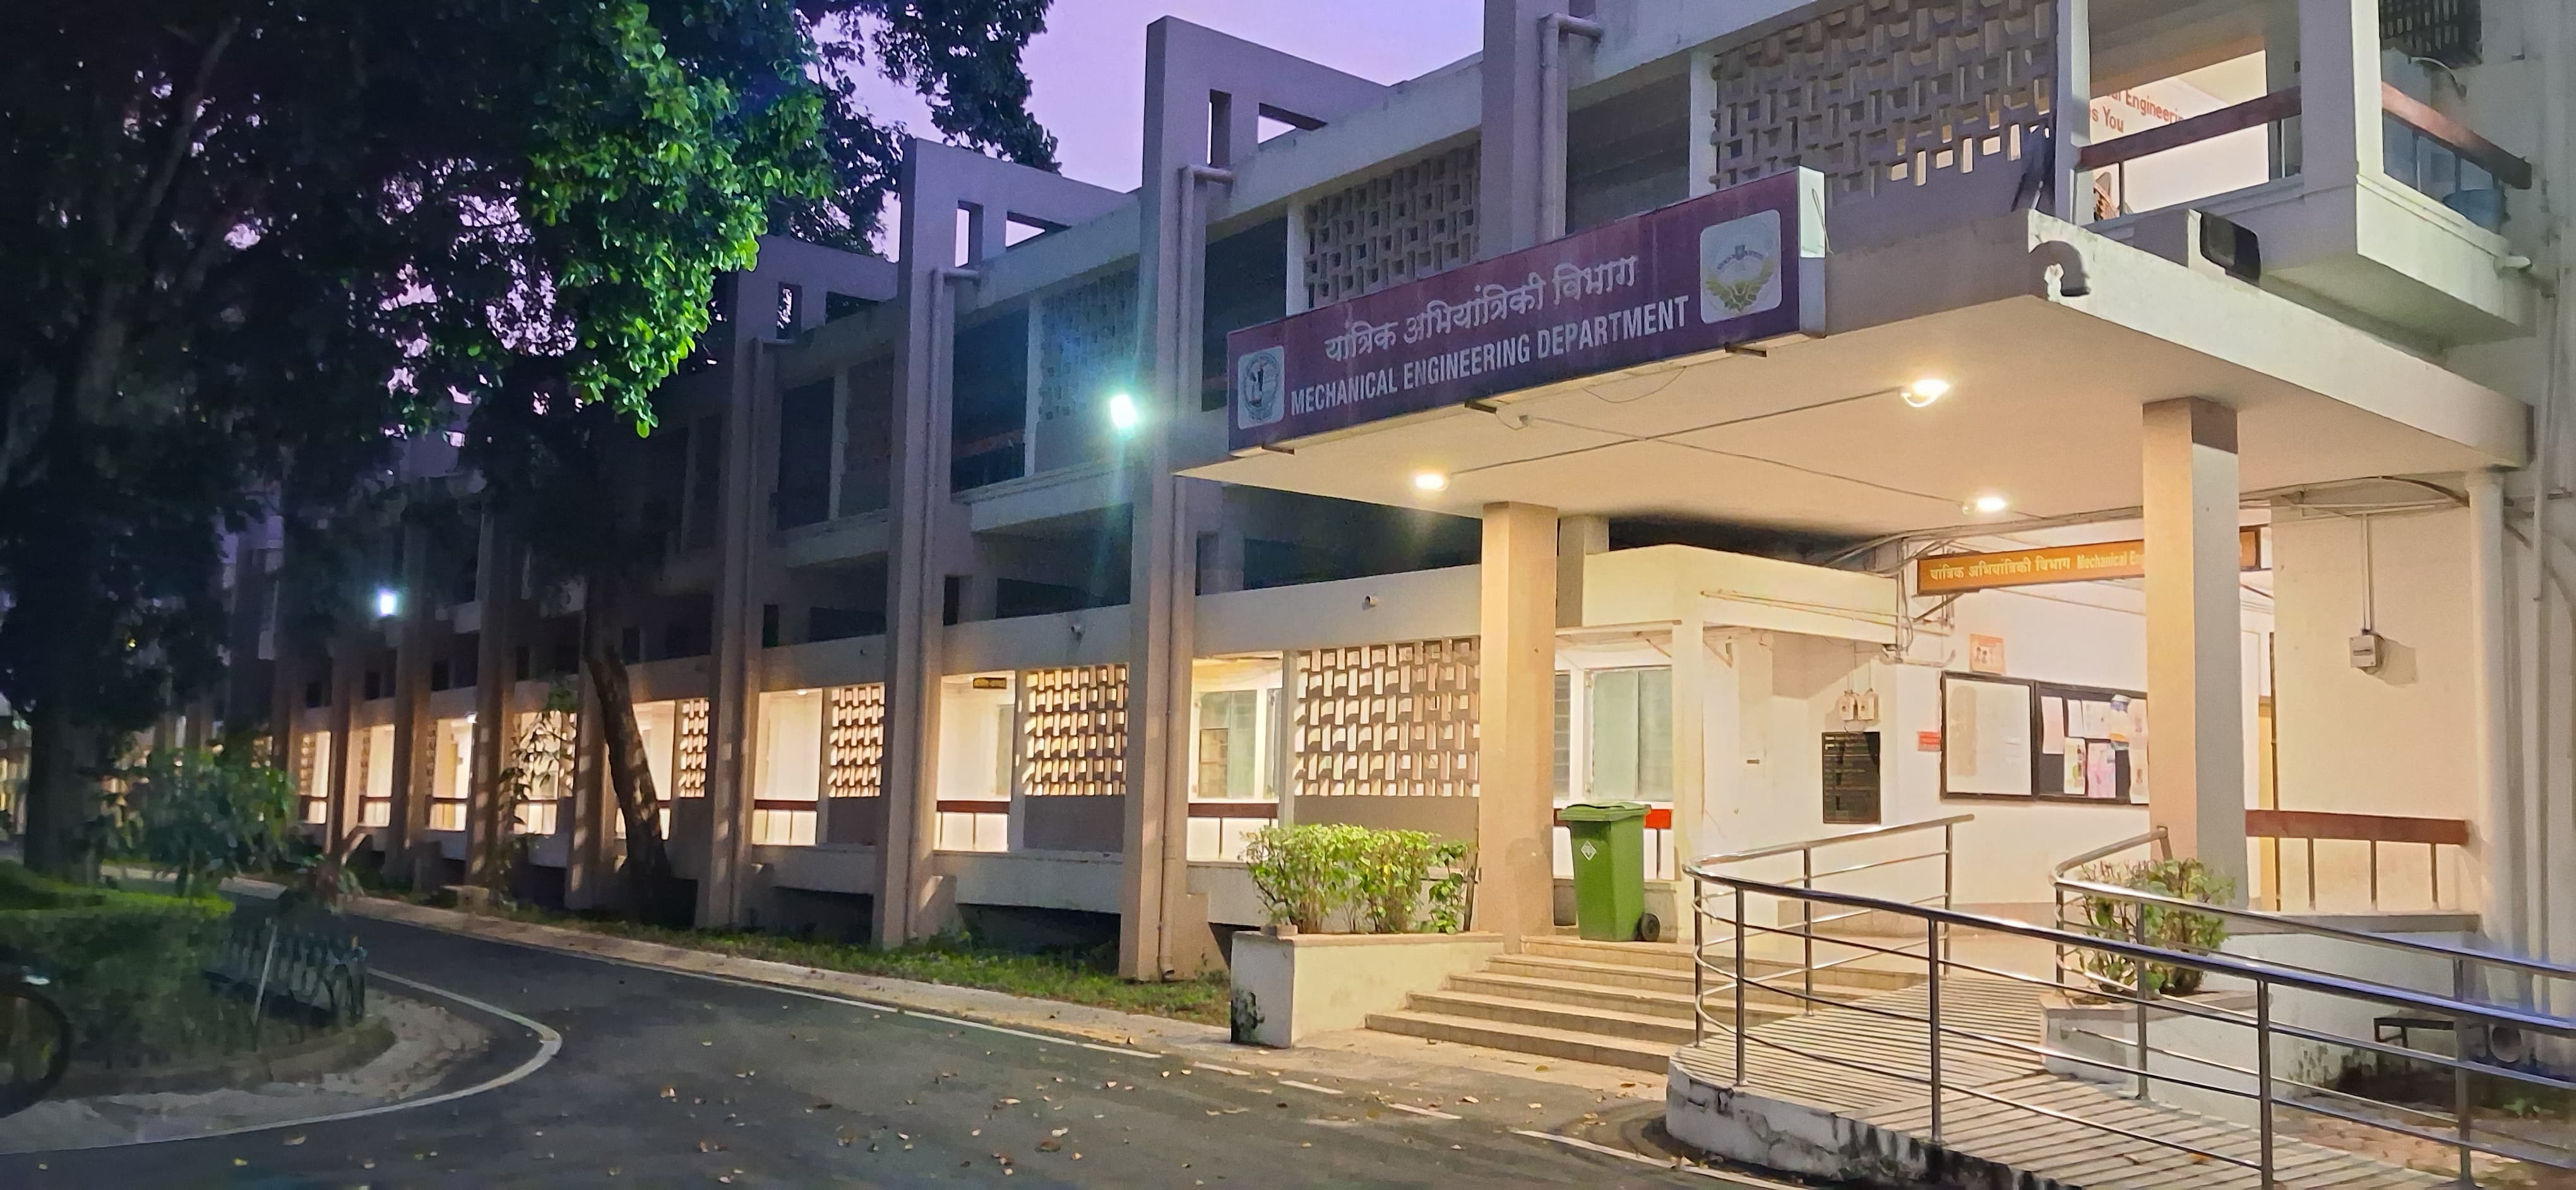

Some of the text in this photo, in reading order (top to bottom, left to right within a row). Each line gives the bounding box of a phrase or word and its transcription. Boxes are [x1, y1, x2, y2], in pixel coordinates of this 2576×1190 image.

[2102, 106, 2124, 133] You
[1324, 255, 1638, 362] यांत्रिक अभियांत्रिकी विभाग
[1291, 368, 1398, 416] MECHANICAL
[1404, 334, 1530, 390] ENGINEERING
[1537, 295, 1689, 359] DEPARTMENT
[2077, 551, 2127, 569] Mechanical
